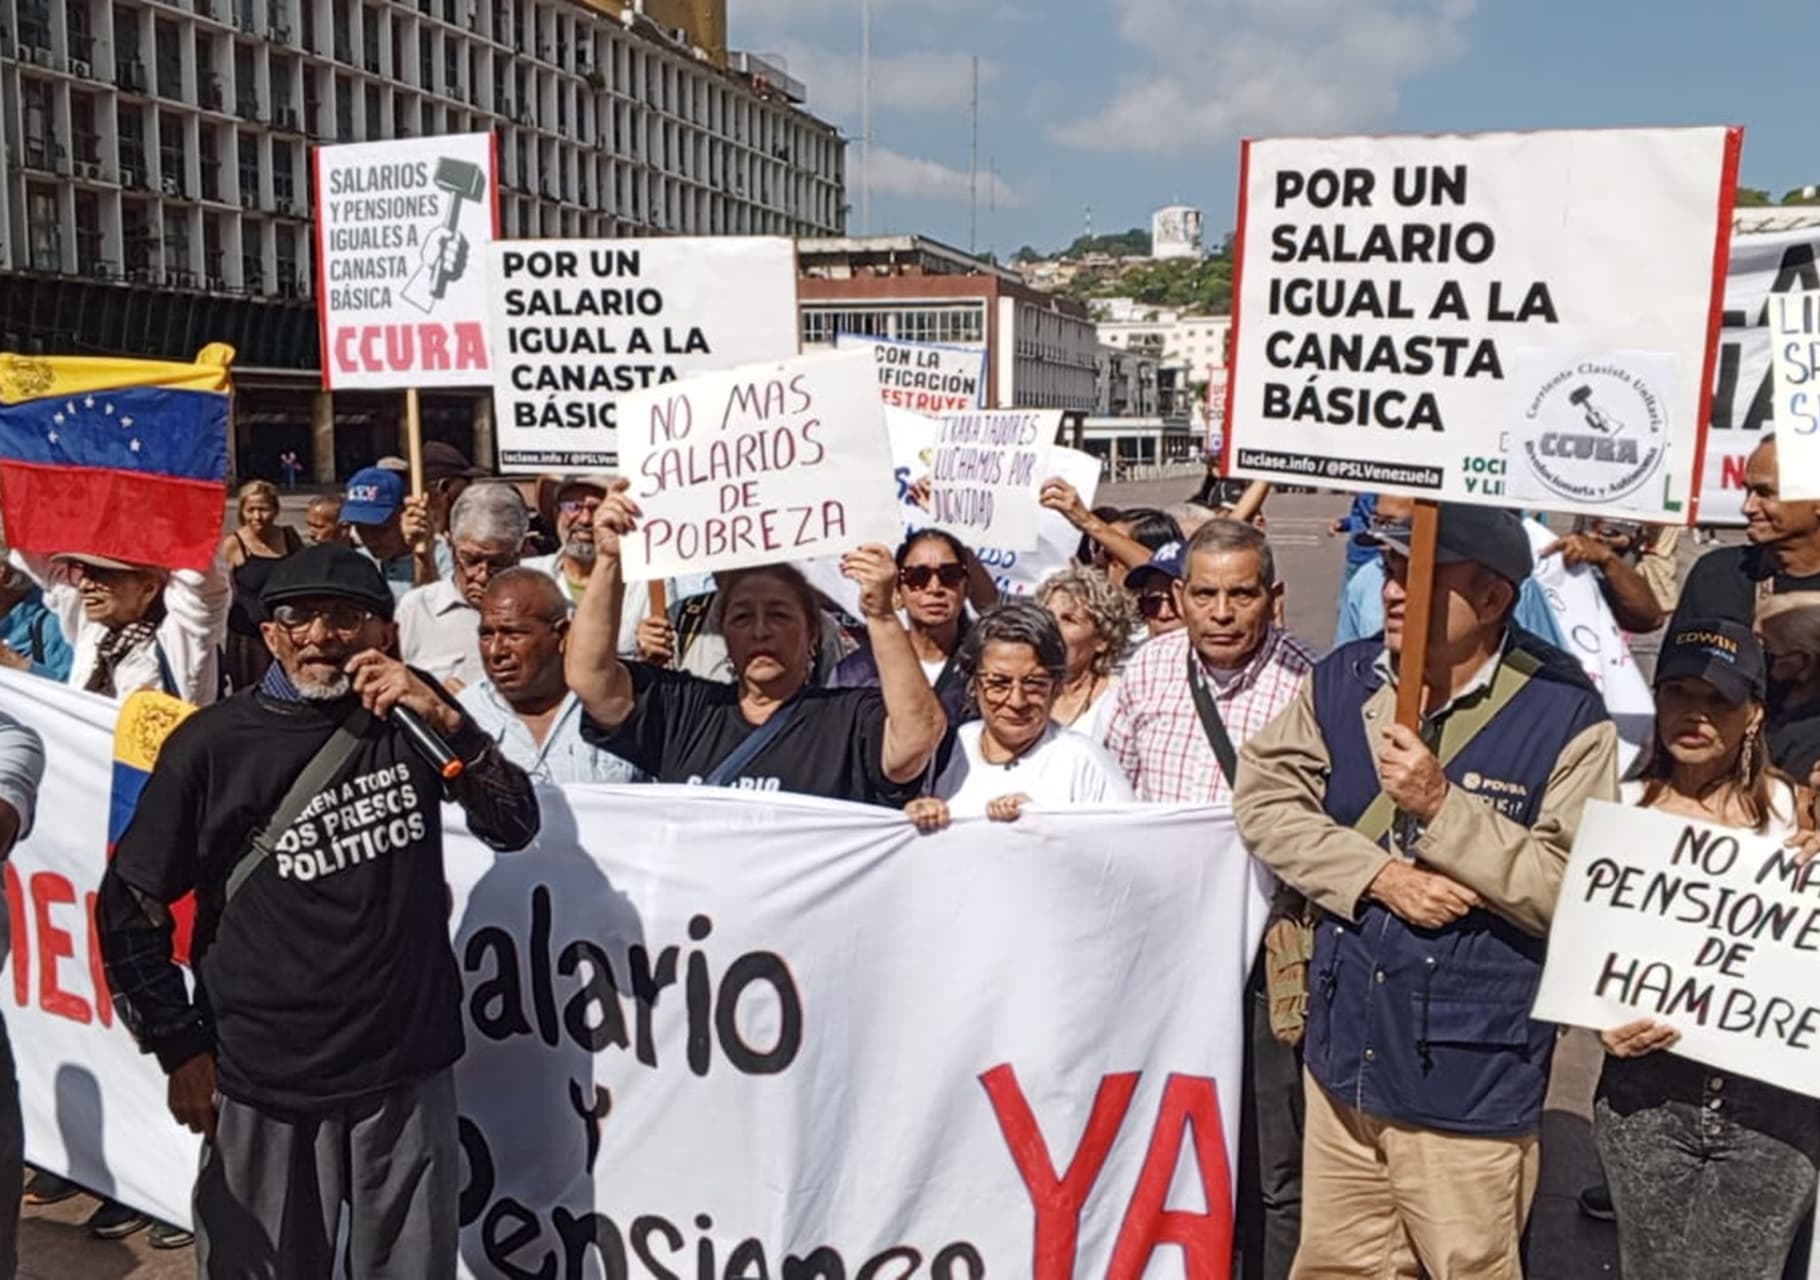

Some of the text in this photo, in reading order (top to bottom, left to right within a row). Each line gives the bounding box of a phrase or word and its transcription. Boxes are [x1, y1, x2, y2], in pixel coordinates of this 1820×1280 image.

[330, 163, 428, 195] SALARIOS
[1275, 165, 1468, 209] POR UN
[330, 195, 439, 223] Y PENSIONES
[330, 224, 419, 251] IGUALES A
[1271, 222, 1495, 264] SALARIO
[330, 256, 408, 282] CANASTA
[503, 250, 640, 278] POR UN
[330, 285, 392, 311] BÁSICA
[505, 289, 663, 317] SALARIO
[1269, 279, 1559, 323] IGUAL A LA
[335, 321, 489, 373] CCURA
[508, 326, 711, 354] IGUAL A LA
[875, 344, 940, 369] CON LA
[1265, 331, 1505, 380] CANASTA
[511, 364, 678, 392] CANASTA
[877, 367, 976, 395] IFICACIÓN
[1577, 363, 1631, 382] Clasista
[514, 395, 617, 428] BÁSIC
[882, 388, 968, 411] ESTRUYE
[1263, 375, 1444, 431] BÁSICA
[649, 393, 693, 445] NO
[640, 419, 826, 499] SALARIOS
[1540, 432, 1638, 465] CCURA
[1007, 451, 1036, 486] POR
[1241, 451, 1315, 473] laclase.info
[1326, 460, 1440, 485] @PSLVenezuela
[1462, 456, 1507, 475] SOCI
[718, 480, 759, 515] DE
[1482, 478, 1506, 496] LI
[641, 500, 847, 566] POBREZA
[1676, 631, 1737, 653] EDWIN
[342, 782, 354, 802] A
[275, 784, 417, 853] OS PRESOS
[1671, 826, 1740, 876] NO
[1584, 857, 1820, 951] PENSIONE
[1694, 937, 1755, 978] DE
[464, 884, 803, 1076] alario
[1595, 952, 1820, 1050] HAMBRE
[978, 1062, 1236, 1280] YA
